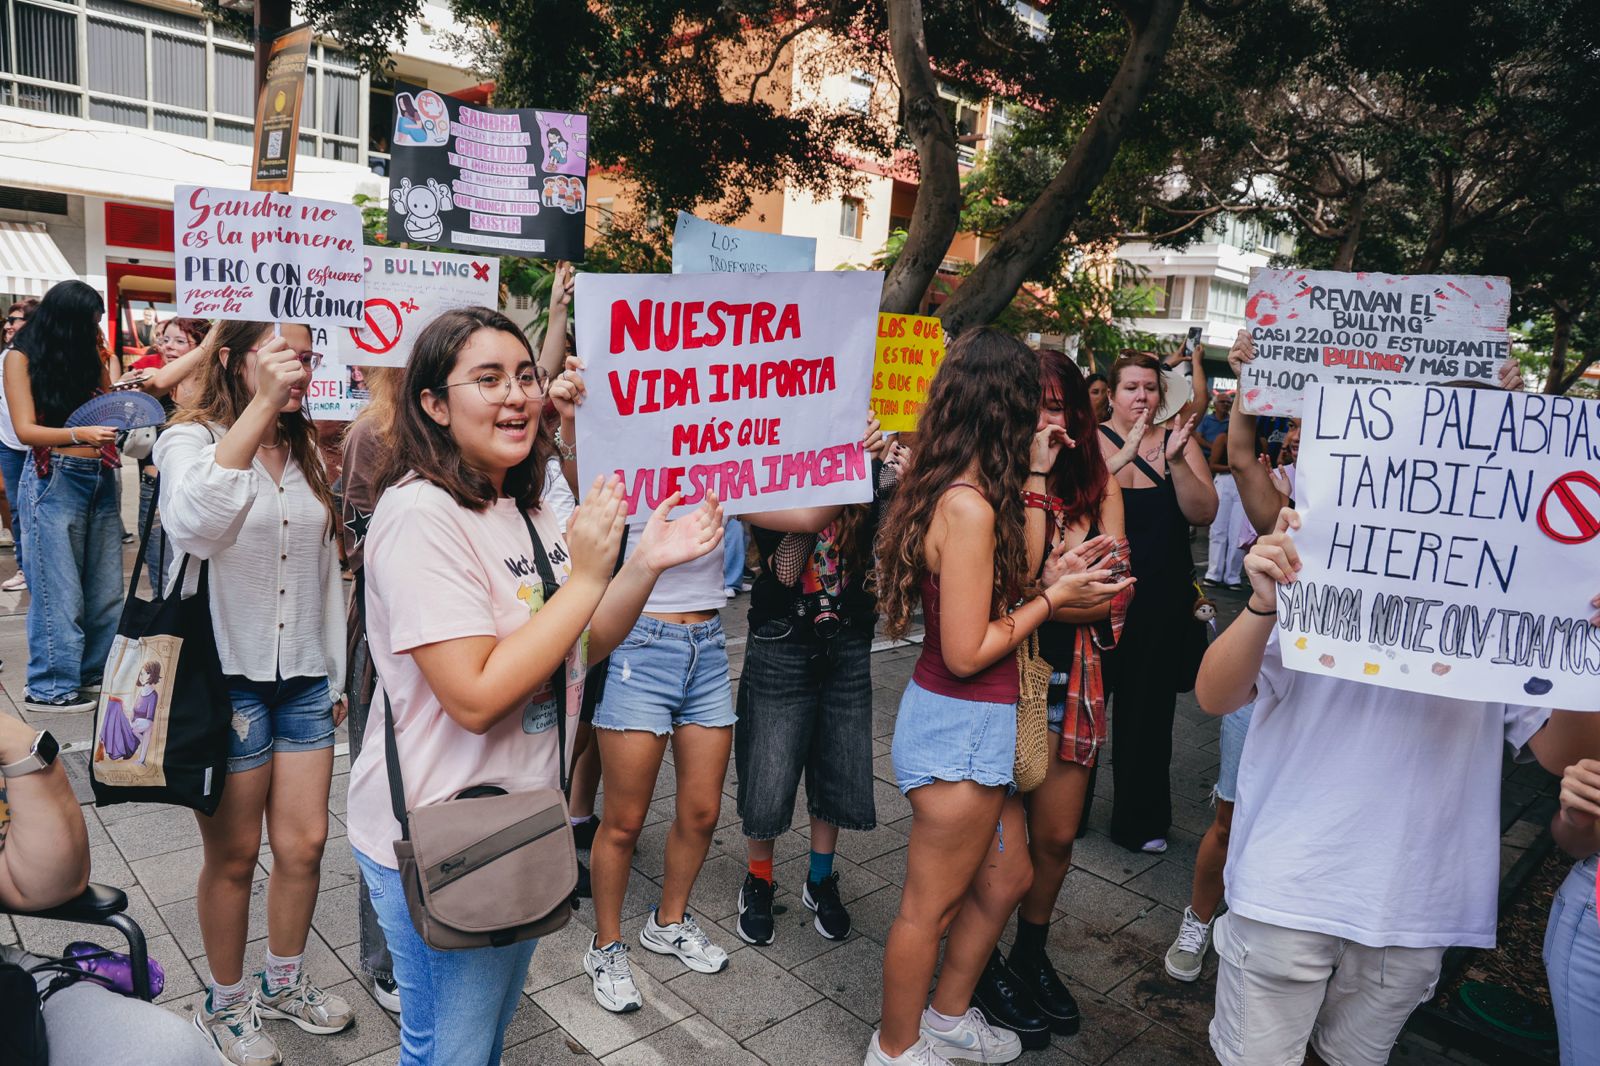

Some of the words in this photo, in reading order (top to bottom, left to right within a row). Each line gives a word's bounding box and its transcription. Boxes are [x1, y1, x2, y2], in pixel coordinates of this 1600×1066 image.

[459, 106, 520, 132] SANDRA
[456, 138, 527, 163] CRUELDAD
[472, 161, 536, 177] INDIFERENCIA
[187, 187, 292, 230] Sandra
[301, 205, 338, 223] no
[455, 195, 473, 207] QUE
[475, 199, 507, 213] NUNCA
[471, 213, 520, 231] EXISTIR
[182, 229, 214, 249] es
[216, 220, 244, 246] la
[251, 226, 356, 254] primera,
[711, 231, 741, 253] LOS
[184, 256, 249, 284] PERO
[256, 262, 301, 286] CON
[307, 265, 363, 287] esfuerzo
[708, 254, 769, 273] PROFESORES
[192, 300, 220, 315] ser
[222, 297, 242, 313] la
[609, 298, 802, 355] NUESTRA
[877, 315, 907, 338] LOS
[913, 319, 940, 340] QUE
[1252, 327, 1291, 342] CASI
[1293, 326, 1379, 349] 220.000
[1386, 335, 1508, 359] ESTUDIANTE
[929, 348, 940, 367] Y
[1251, 342, 1319, 364] SUFREN
[1322, 346, 1405, 374] BULLYNG
[1403, 355, 1416, 373] Y
[1419, 355, 1460, 377] MÁS
[1463, 359, 1495, 379] DE
[608, 366, 700, 417] VIDA
[708, 355, 837, 404] IMPORTA
[887, 372, 912, 392] QUE
[308, 402, 341, 412] SANDRA
[1315, 385, 1394, 441] LAS
[672, 417, 734, 456] MÁS
[737, 417, 782, 446] QUE
[614, 457, 758, 516] VUESTRA
[760, 440, 867, 495] IMAGEN
[1329, 451, 1534, 523] TAMBIÉN
[503, 553, 536, 579] Not
[1327, 521, 1519, 594] HIEREN
[1276, 579, 1363, 643] SANDRA
